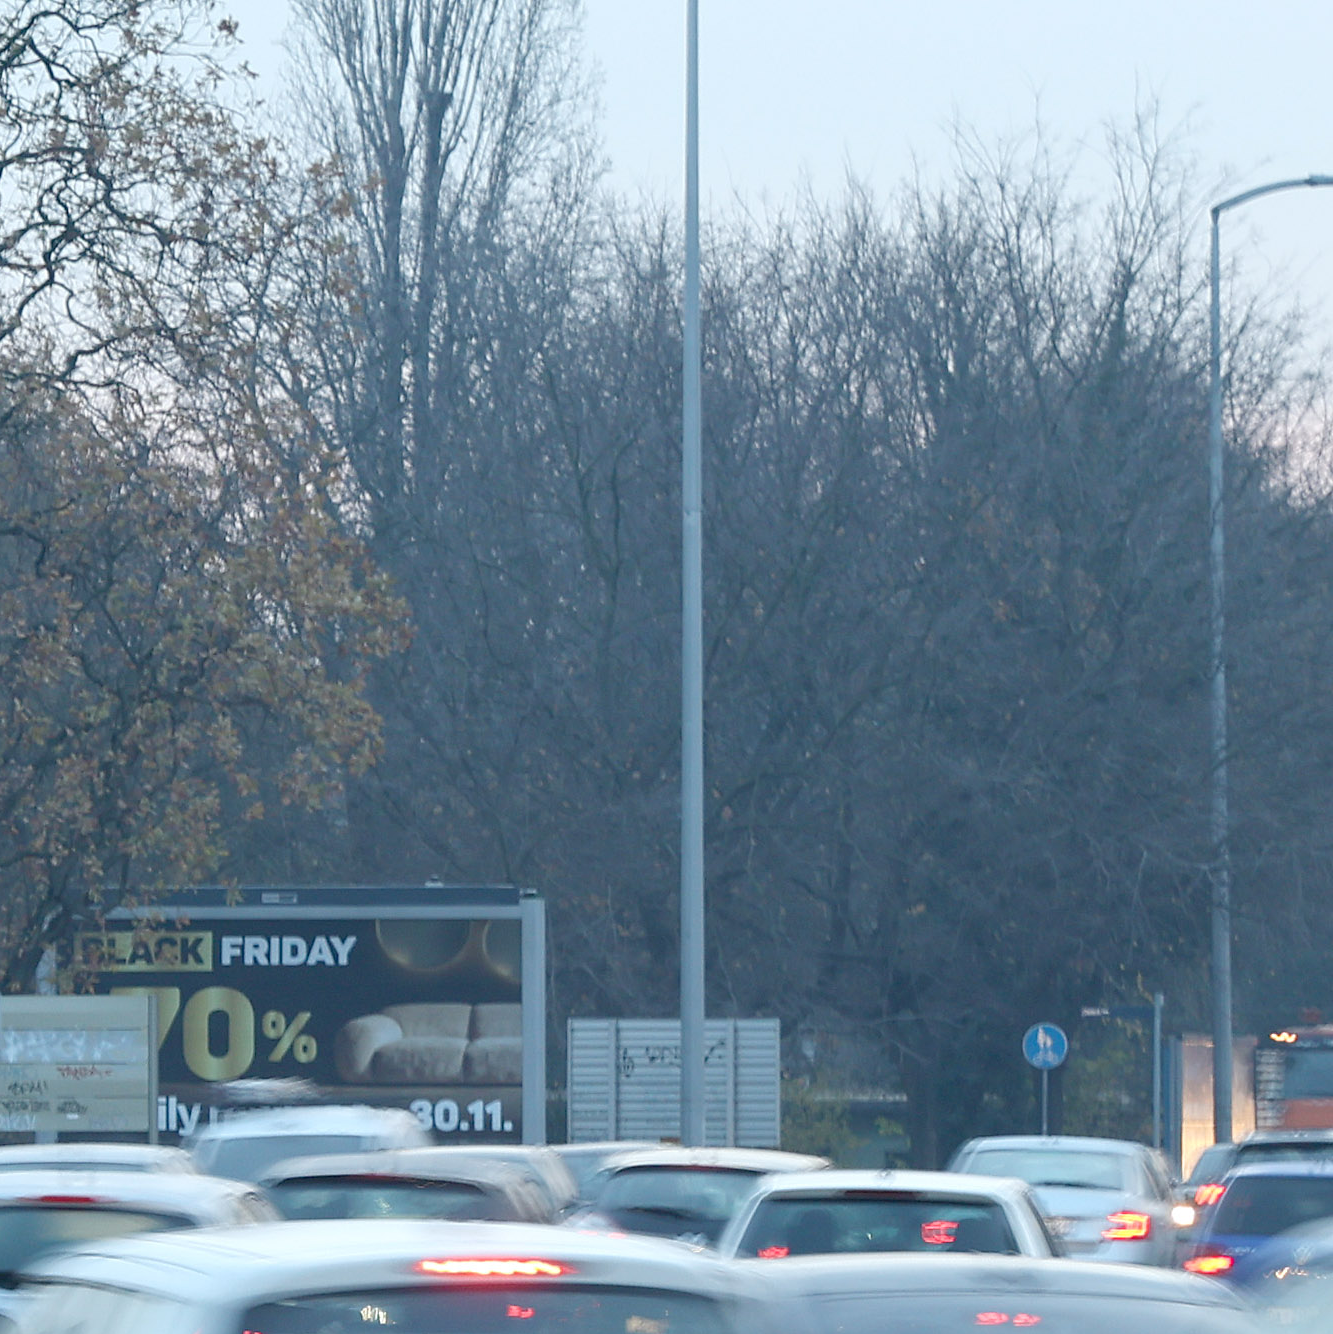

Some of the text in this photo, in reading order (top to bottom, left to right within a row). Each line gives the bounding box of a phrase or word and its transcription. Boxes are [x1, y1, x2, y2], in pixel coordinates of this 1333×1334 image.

[81, 935, 357, 967] BLACK FRIDAY
[409, 1098, 513, 1132] 30.11.
